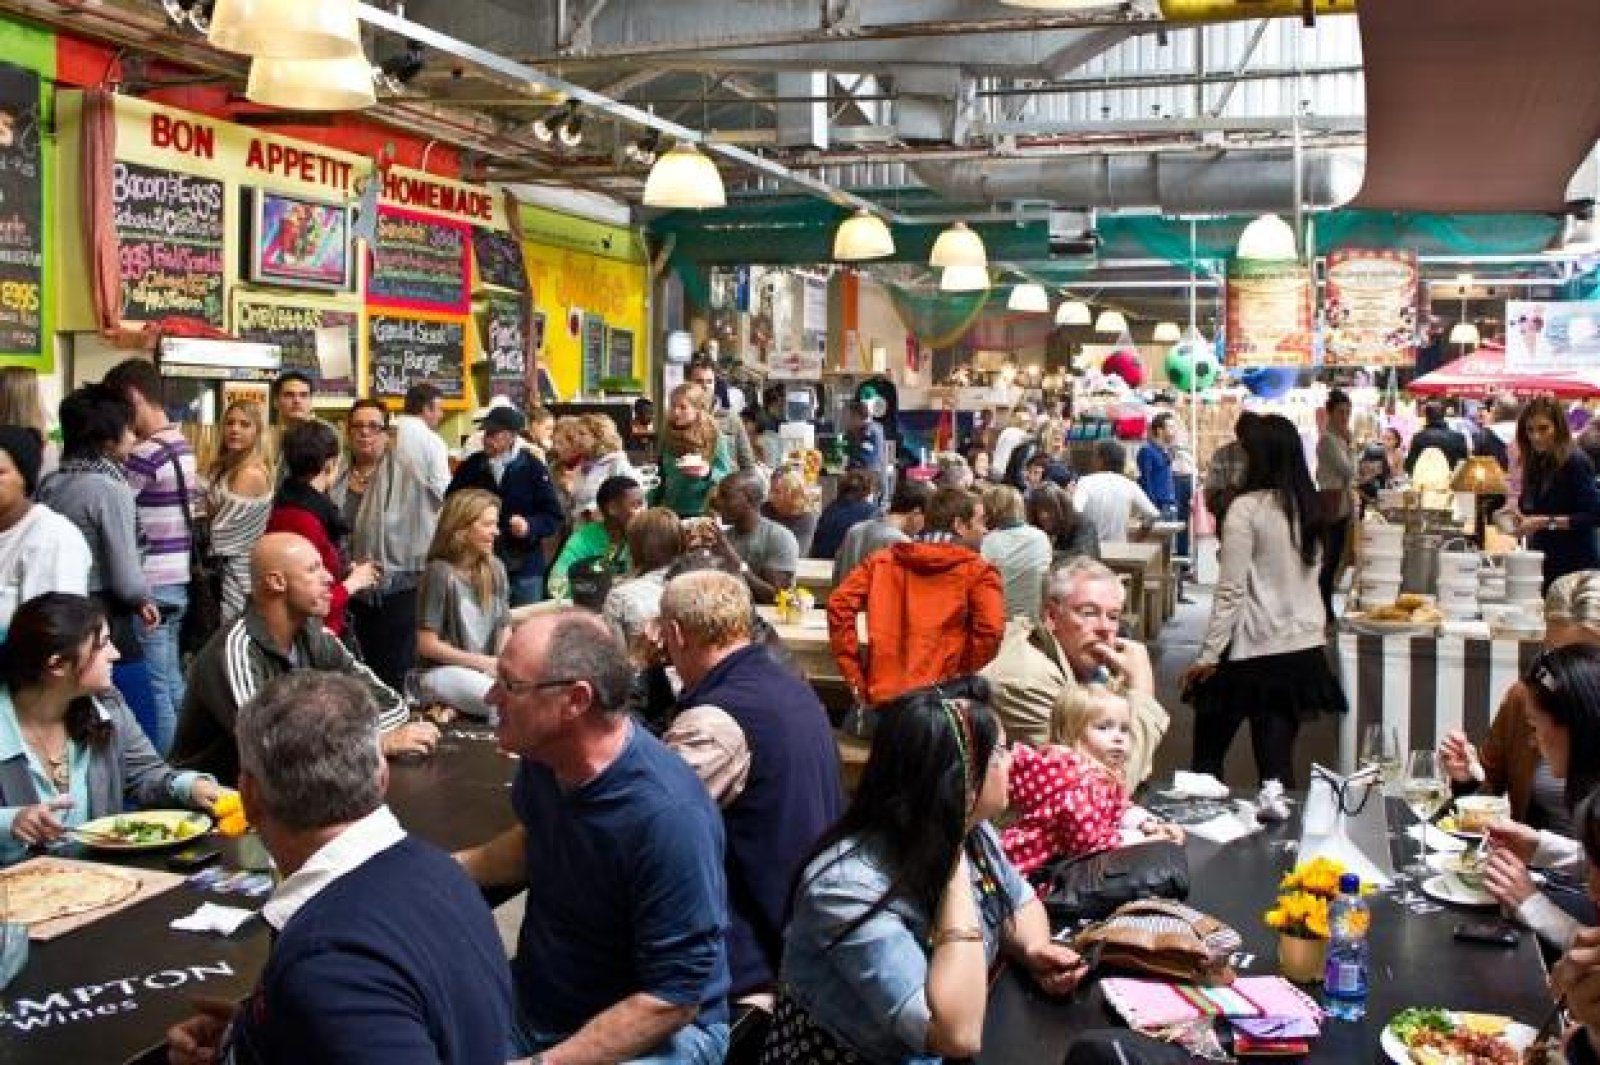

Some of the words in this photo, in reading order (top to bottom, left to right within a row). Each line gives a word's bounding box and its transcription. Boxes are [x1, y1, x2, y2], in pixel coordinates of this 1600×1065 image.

[150, 113, 214, 159] BON
[245, 138, 353, 197] APPETIT
[380, 168, 493, 220] HOMEMADE
[119, 242, 152, 280] ggs
[12, 999, 139, 1031] Wines
